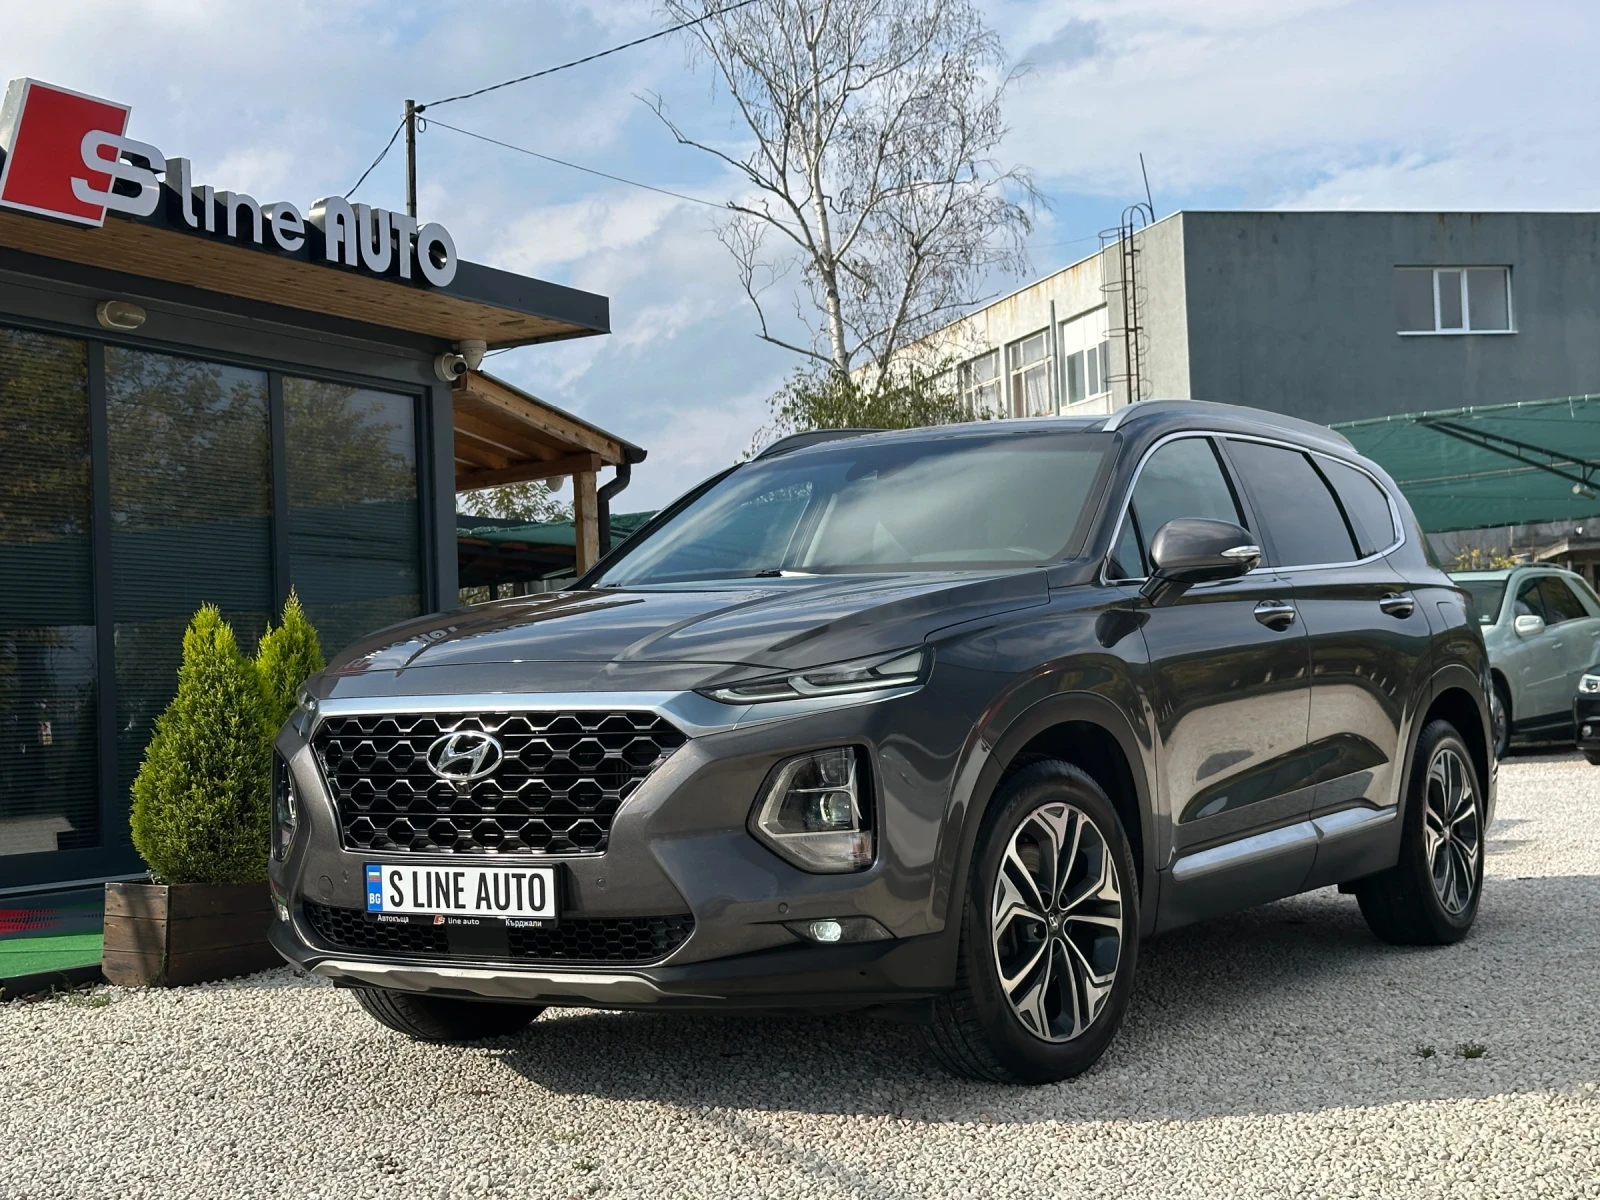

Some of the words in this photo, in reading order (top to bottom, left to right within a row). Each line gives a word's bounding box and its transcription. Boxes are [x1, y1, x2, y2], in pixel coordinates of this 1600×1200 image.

[178, 157, 305, 252] line
[323, 196, 458, 287] AUTO
[389, 870, 405, 908] S
[412, 870, 466, 910] LINE
[475, 872, 546, 912] AUTO
[369, 893, 381, 905] BG
[377, 914, 410, 924] Автокъща
[448, 917, 461, 925] line
[505, 918, 543, 928] Кърджали
